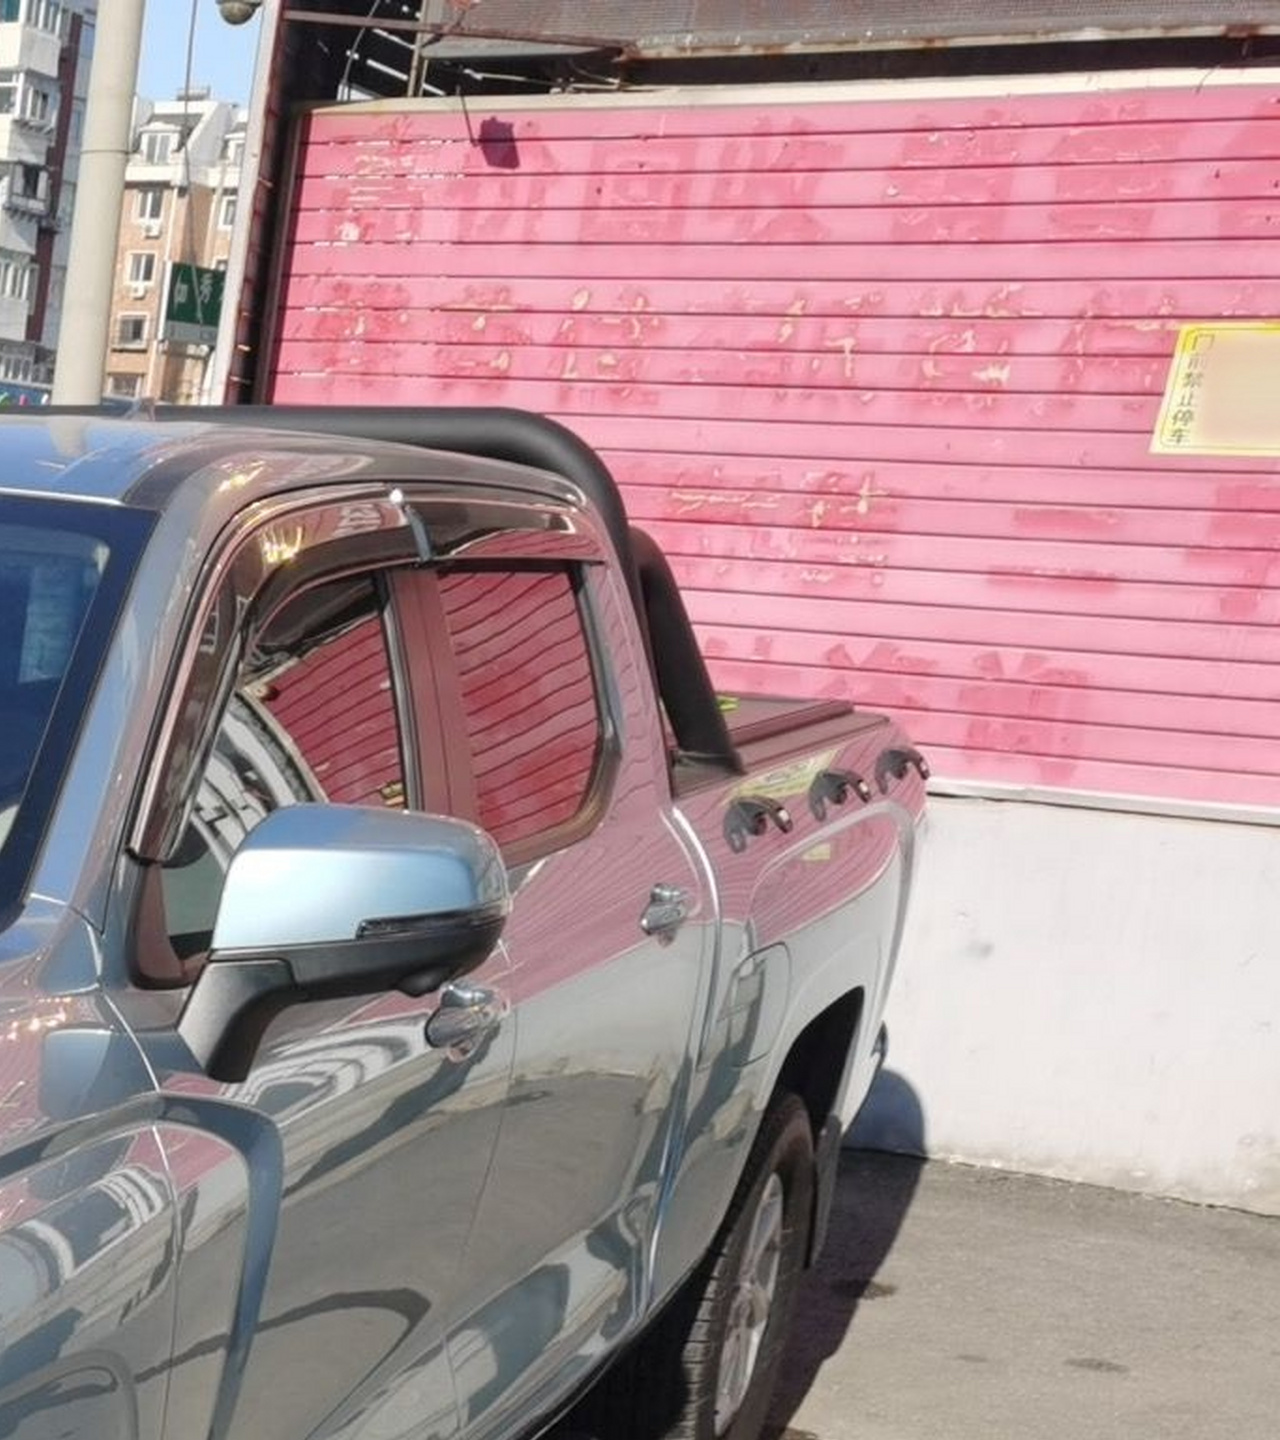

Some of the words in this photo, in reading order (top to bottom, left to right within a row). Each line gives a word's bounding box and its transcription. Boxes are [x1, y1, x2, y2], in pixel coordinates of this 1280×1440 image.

[1167, 333, 1216, 444] 门前禁止停车
